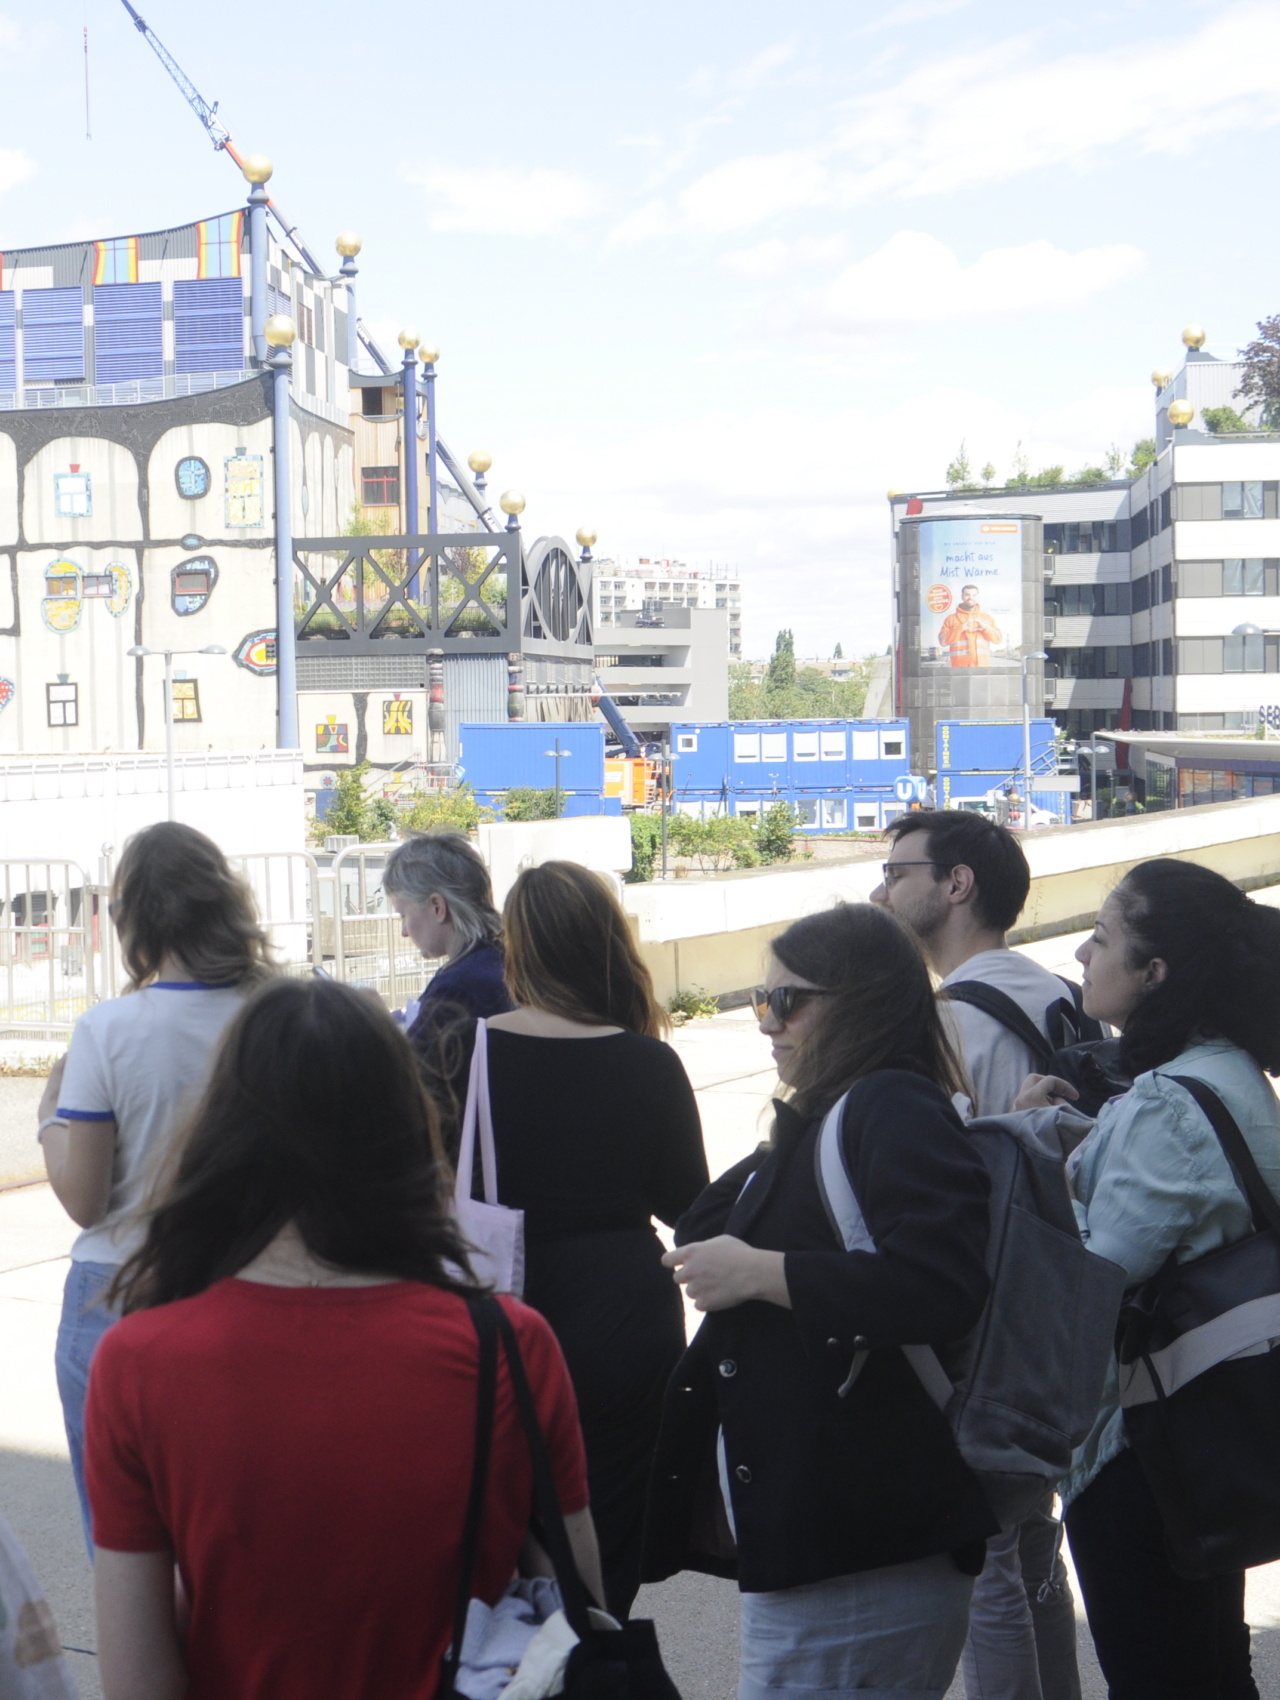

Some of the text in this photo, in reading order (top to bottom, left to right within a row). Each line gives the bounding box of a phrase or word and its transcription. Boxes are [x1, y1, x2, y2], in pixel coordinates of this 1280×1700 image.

[945, 551, 994, 563] macht aus
[939, 566, 1001, 578] Mist Wärme.
[897, 783, 912, 800] U
[917, 782, 926, 800] U
